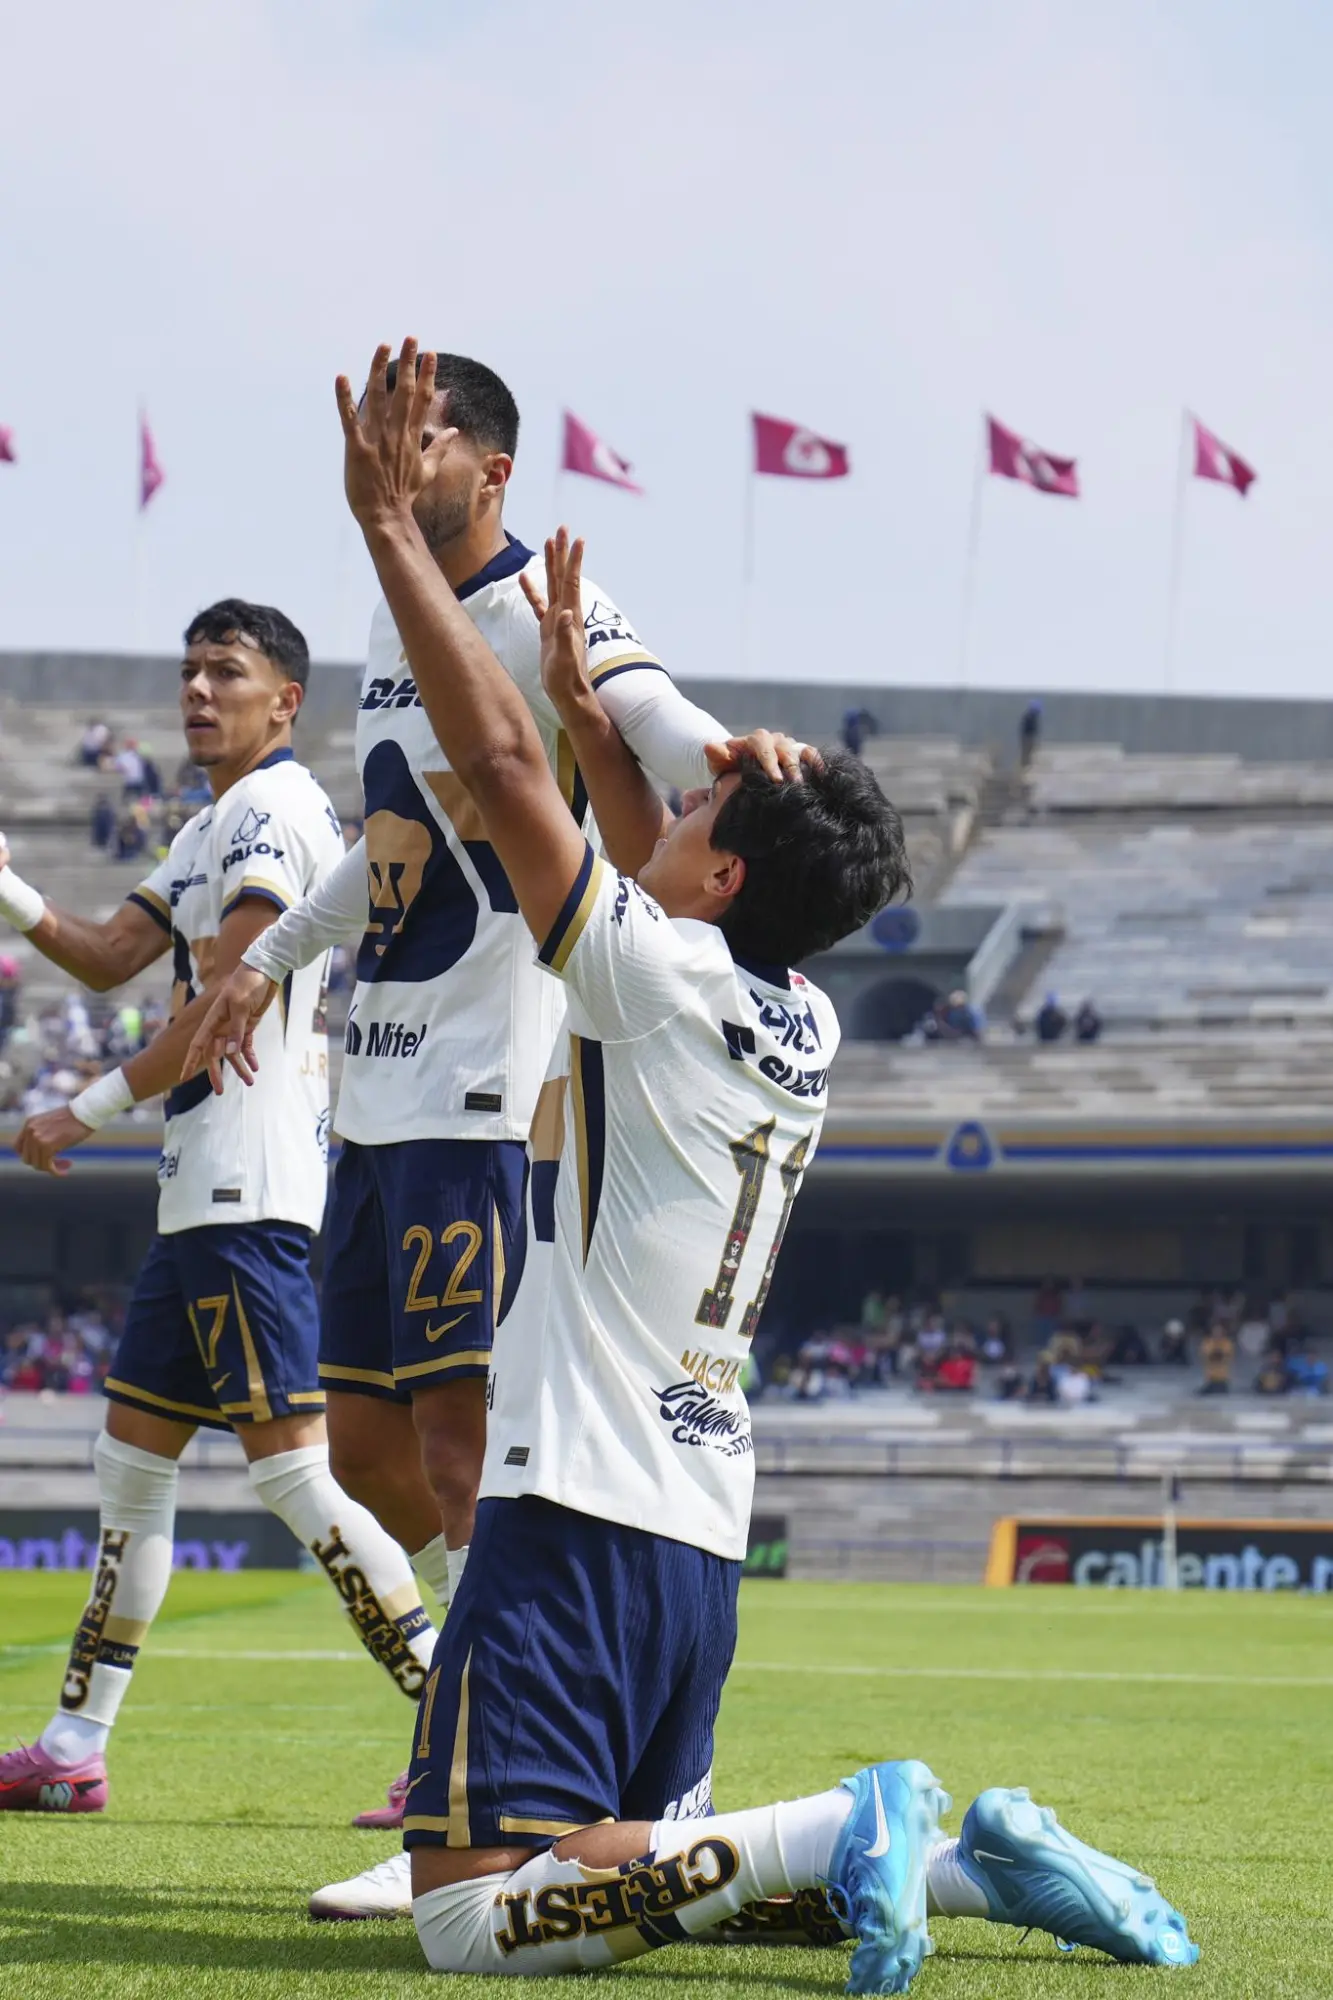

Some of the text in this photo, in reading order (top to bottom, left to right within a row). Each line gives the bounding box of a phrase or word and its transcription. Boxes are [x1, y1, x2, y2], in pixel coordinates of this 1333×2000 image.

[365, 1022, 427, 1058] Mifel
[402, 1221, 483, 1313] 22
[694, 1114, 813, 1338] 11
[495, 1835, 740, 1955] CREST
